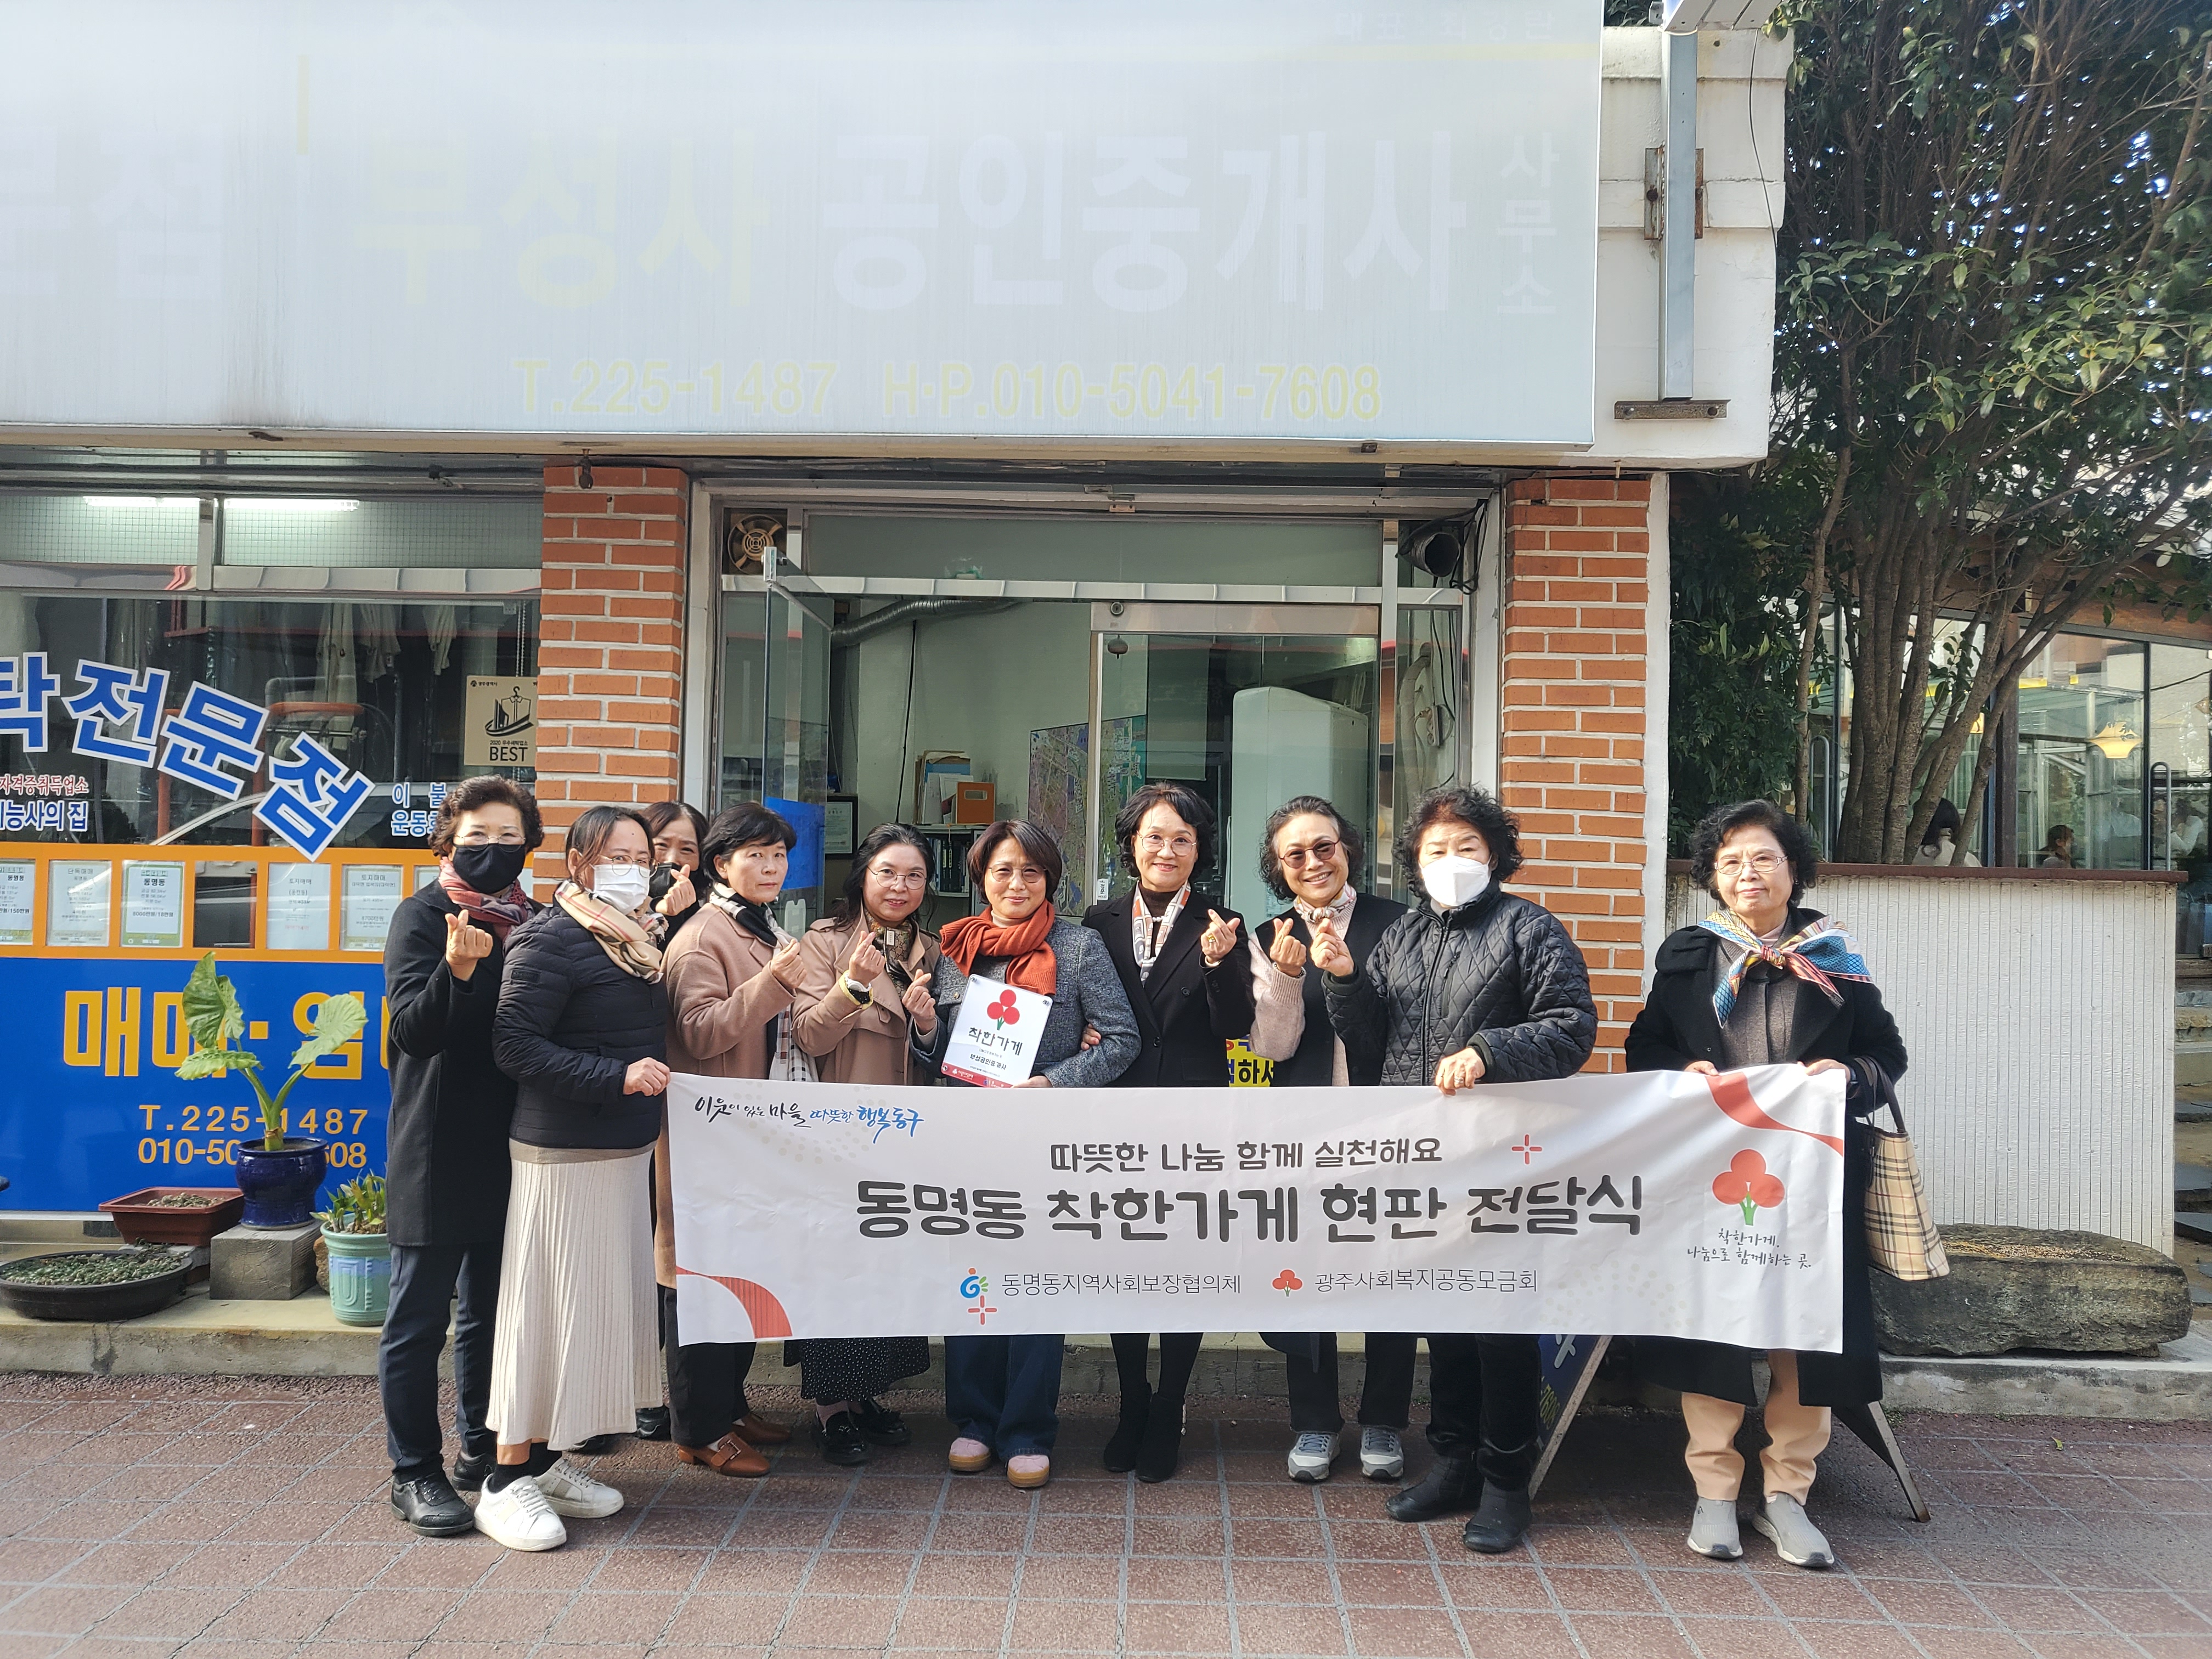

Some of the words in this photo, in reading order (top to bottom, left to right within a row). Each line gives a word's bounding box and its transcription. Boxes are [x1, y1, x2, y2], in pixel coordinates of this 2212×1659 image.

[824, 128, 1466, 312] 공인중개사
[1496, 132, 1560, 314] 사무소
[511, 358, 839, 417] T.225-1487
[489, 747, 528, 761] BEST
[0, 800, 64, 831] 능사의
[67, 800, 88, 832] 집
[968, 1027, 1023, 1056] 착한가게
[809, 1109, 854, 1124] 따뜻한
[1051, 1142, 1149, 1173] 따뜻한
[1161, 1143, 1226, 1172] 나눔
[1236, 1141, 1304, 1170] 함께
[1314, 1137, 1443, 1168] 실천해요
[856, 1181, 1027, 1240] 동명동
[1046, 1187, 1299, 1243] 착한가게
[1320, 1183, 1447, 1243] 현판
[1466, 1174, 1643, 1236] 전달식
[1687, 1246, 1731, 1262] 나눔으로
[1001, 1272, 1242, 1297] 동명동지역사회보장협의체
[1314, 1268, 1538, 1293] 광주사회복지공동모금회
